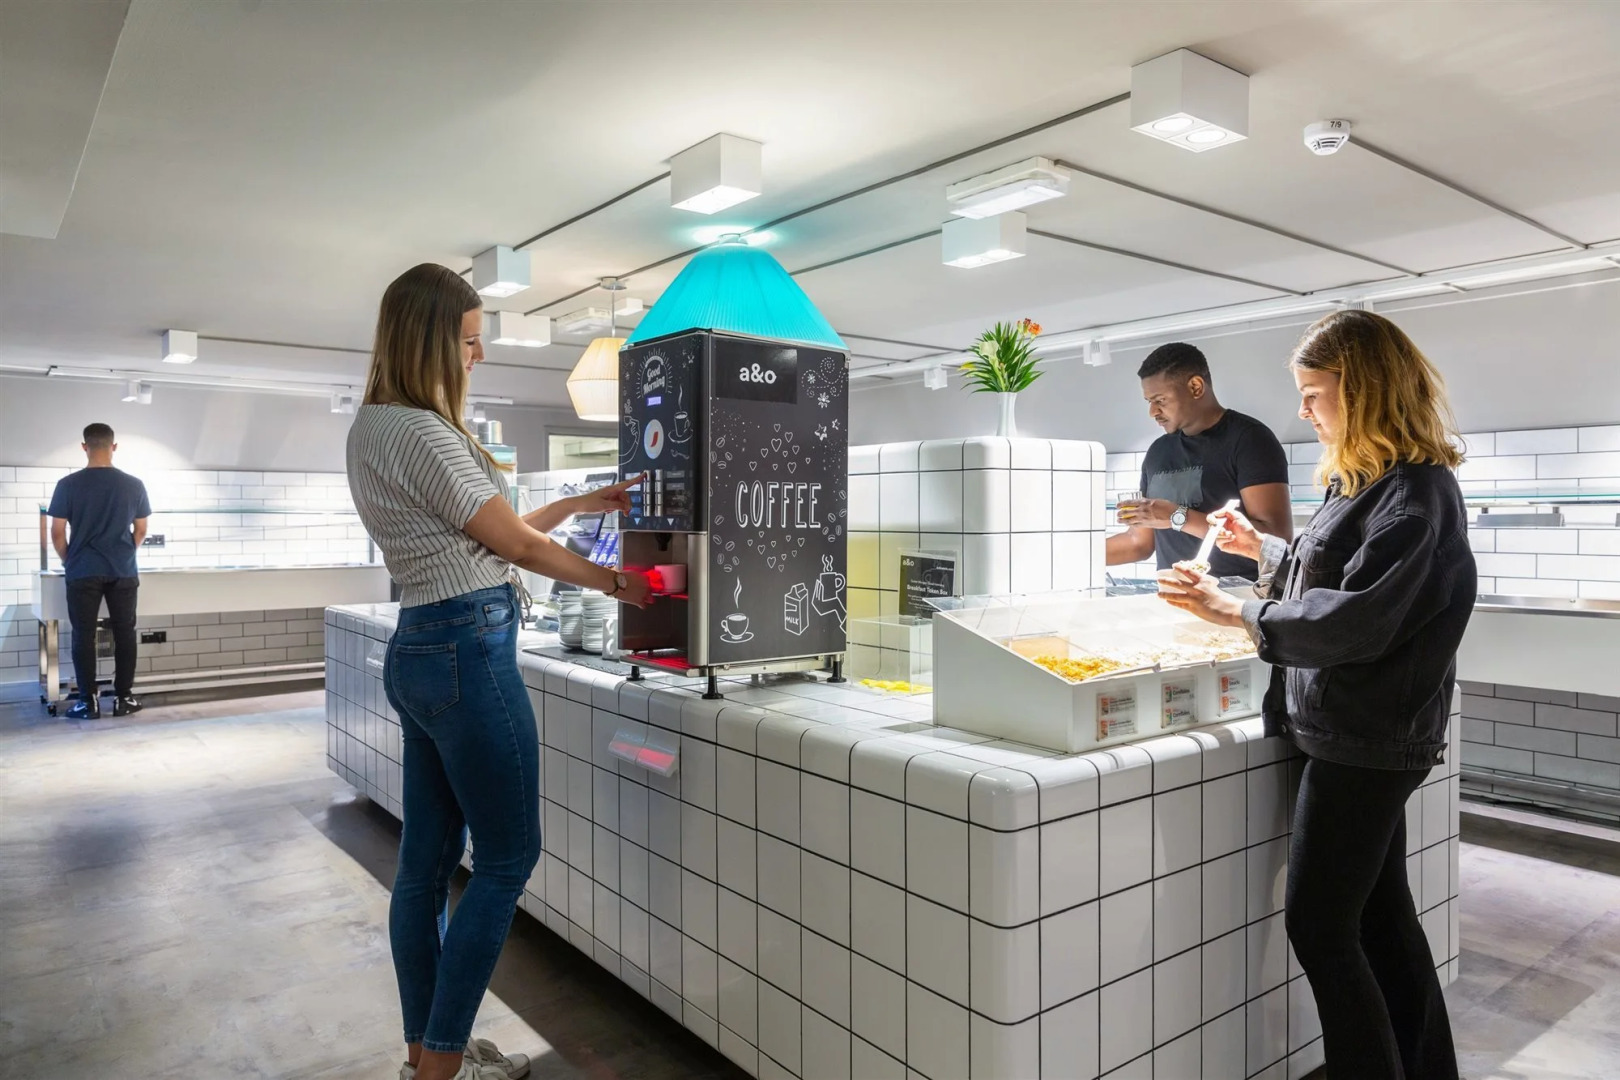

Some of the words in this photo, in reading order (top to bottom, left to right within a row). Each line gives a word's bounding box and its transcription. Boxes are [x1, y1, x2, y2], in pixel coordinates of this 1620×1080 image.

[1330, 120, 1342, 128] 7/9
[646, 364, 661, 381] Good
[739, 362, 777, 385] a&o
[643, 376, 665, 395] Morning
[735, 480, 822, 528] COFFEE
[907, 584, 926, 592] Breakfast
[940, 588, 948, 596] Box
[785, 615, 799, 625] MILK
